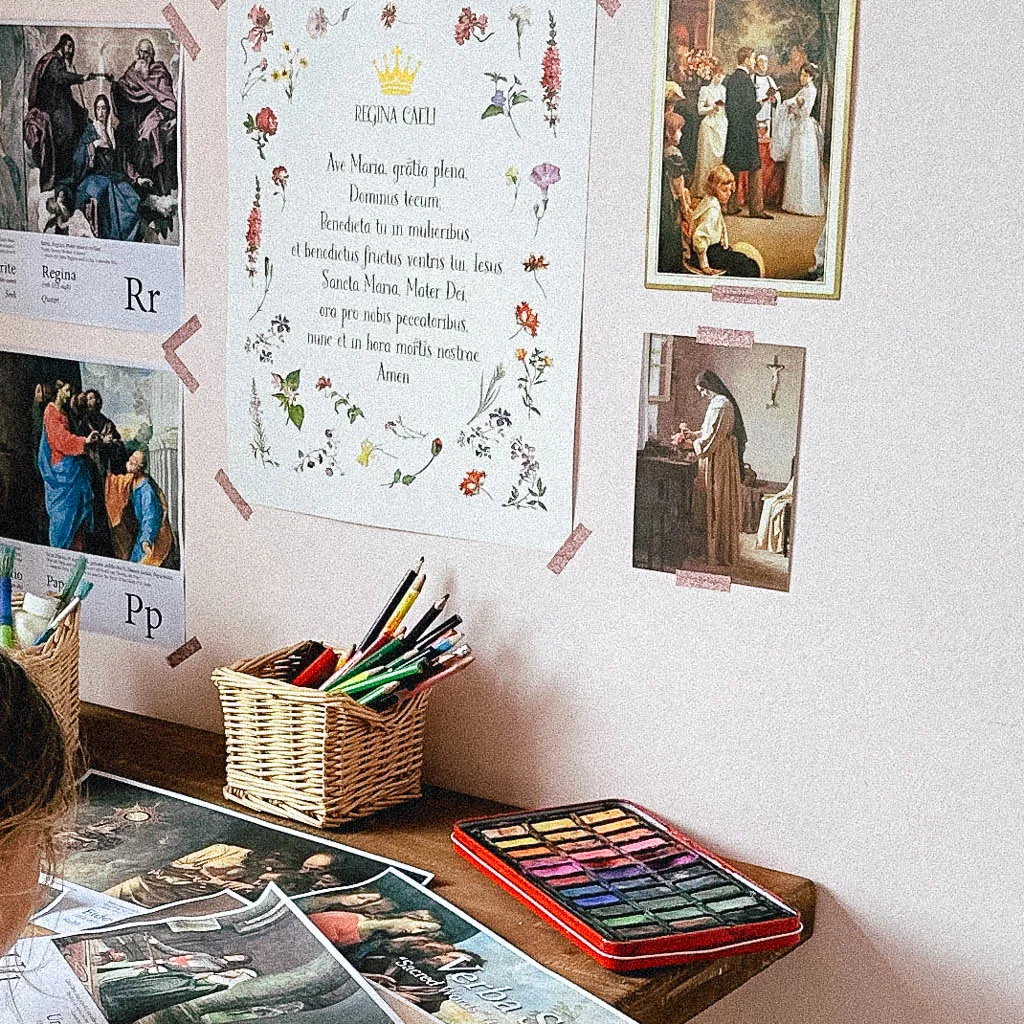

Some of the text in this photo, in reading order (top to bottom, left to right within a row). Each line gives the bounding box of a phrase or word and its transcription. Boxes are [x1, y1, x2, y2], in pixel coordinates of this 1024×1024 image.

[355, 104, 397, 126] REGINA
[327, 151, 345, 172] Ave
[350, 184, 399, 206] Dominus
[320, 210, 370, 234] Benedicta
[376, 218, 387, 235] tu
[392, 224, 403, 236] in
[291, 241, 301, 258] et
[304, 241, 359, 263] benedictus
[362, 245, 402, 269] fructus
[408, 253, 445, 271] ventris
[42, 264, 77, 284] Regina
[321, 269, 360, 292] Sancta
[407, 277, 440, 299] Mater
[124, 276, 161, 314] Rr
[319, 306, 337, 319] ora
[342, 308, 359, 329] pro
[364, 306, 392, 325] nobis
[307, 332, 333, 347] nunc
[337, 333, 347, 349] et
[351, 337, 362, 350] in
[366, 333, 391, 353] hora
[376, 361, 410, 385] Amen
[47, 574, 66, 592] Pap
[125, 593, 163, 640] Pp
[437, 954, 523, 1014] Verba
